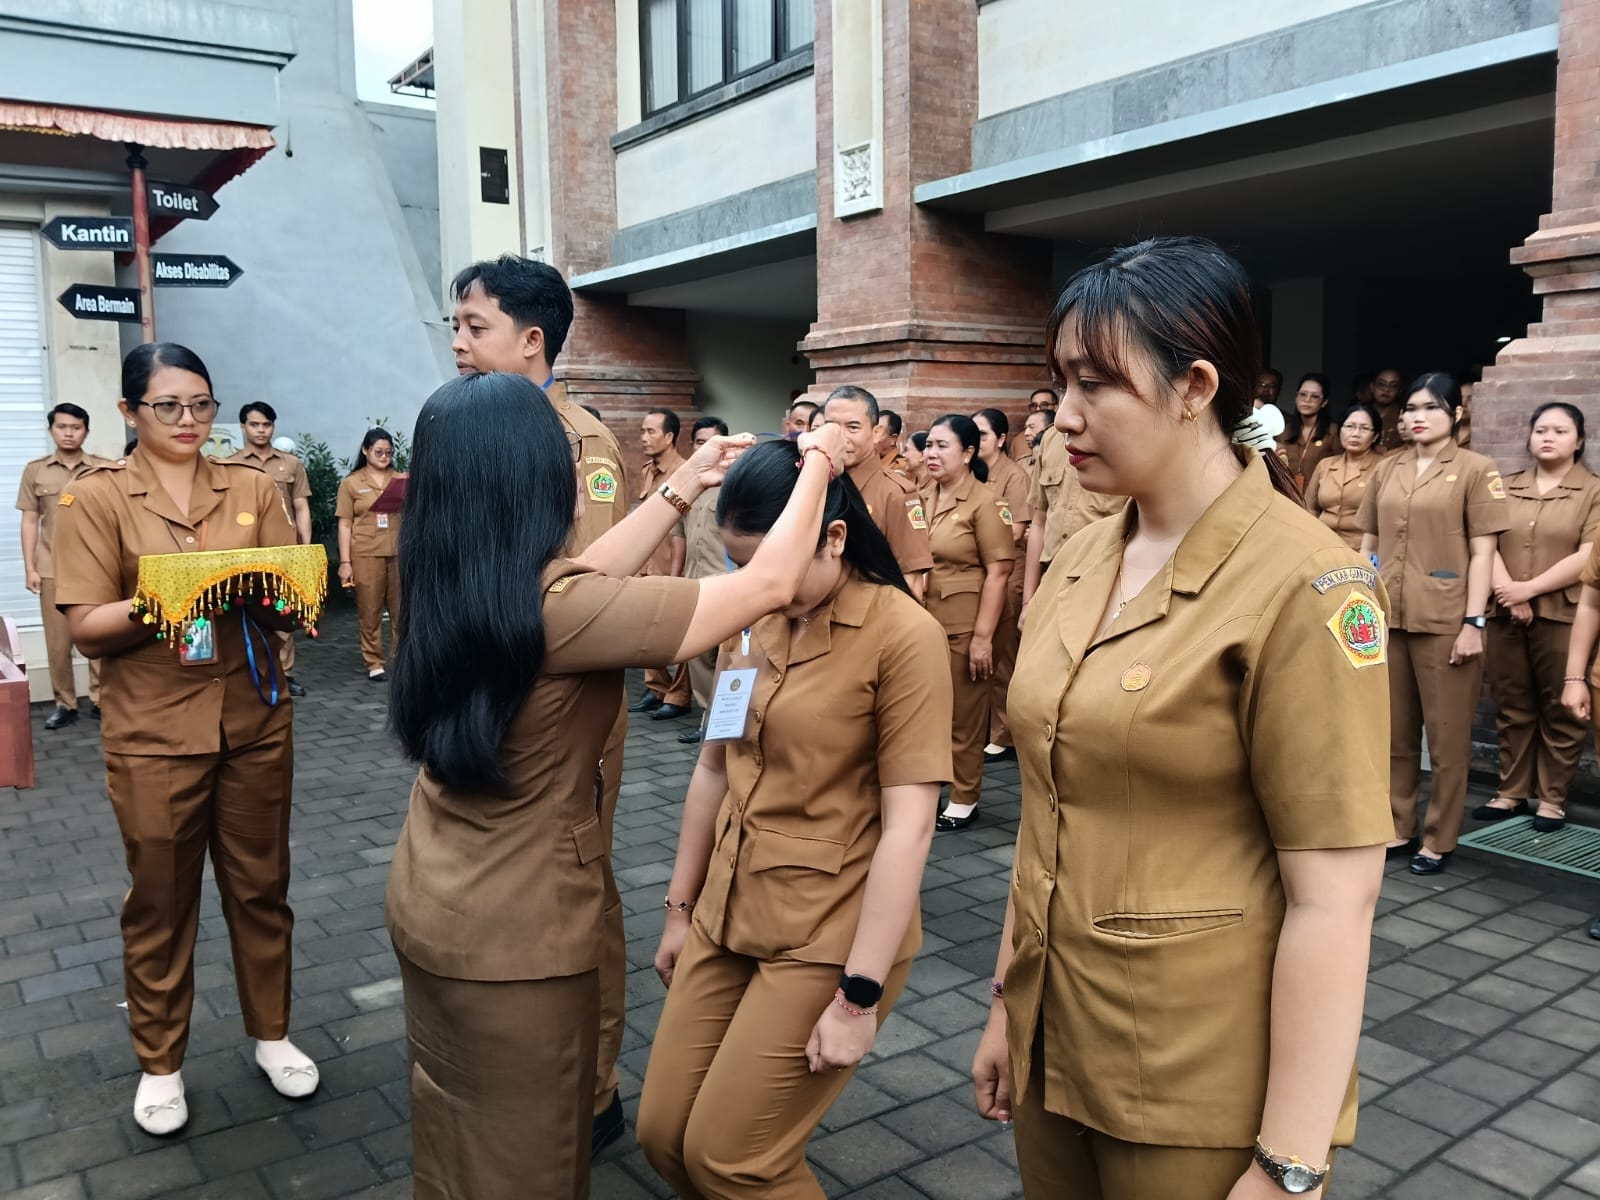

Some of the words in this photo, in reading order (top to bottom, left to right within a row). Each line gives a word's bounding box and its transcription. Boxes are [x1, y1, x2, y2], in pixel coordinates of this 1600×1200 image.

[152, 189, 199, 212] Toilet
[60, 223, 129, 243] Kantin
[155, 261, 183, 279] Akses
[184, 262, 230, 281] Disabilitas
[75, 293, 97, 312] Area
[97, 294, 135, 314] Bermain
